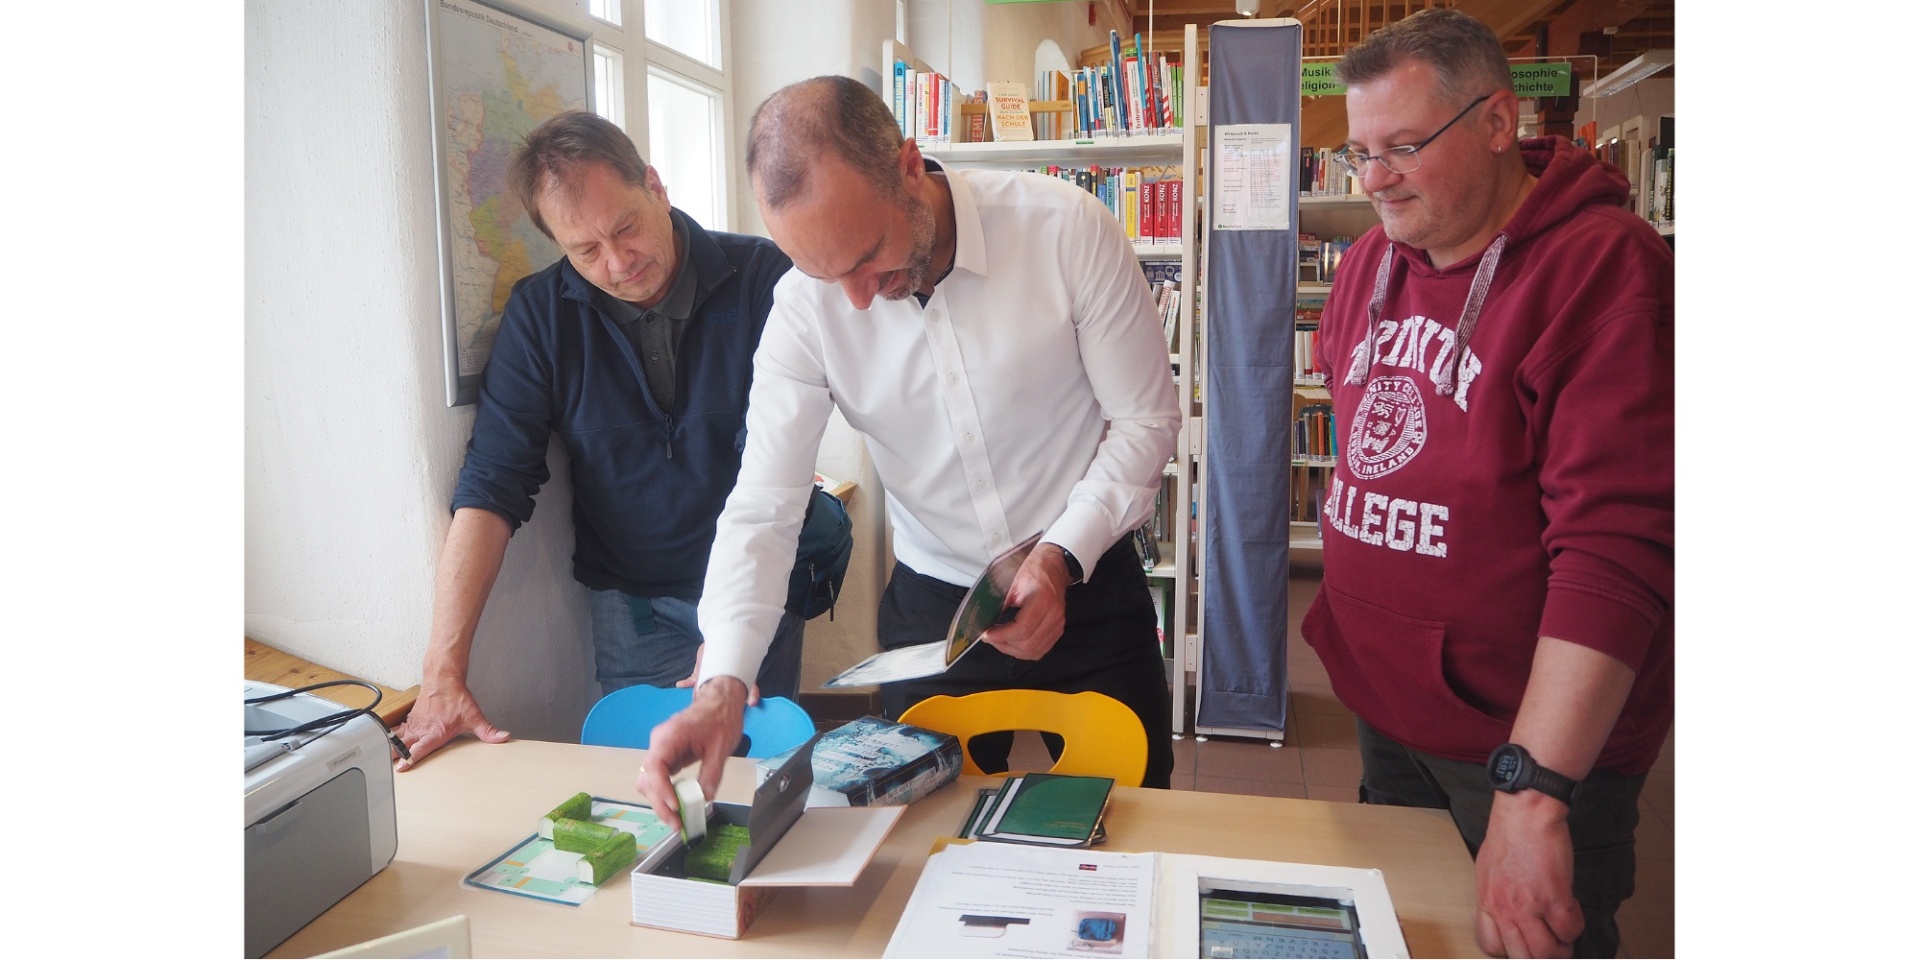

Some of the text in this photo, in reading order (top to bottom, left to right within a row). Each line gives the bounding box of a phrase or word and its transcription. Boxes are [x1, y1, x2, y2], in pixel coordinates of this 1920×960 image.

[440, 0, 518, 33] Bundesrepublik Deutschland
[1302, 67, 1331, 77] Musik
[1511, 68, 1558, 80] osophie
[1361, 446, 1414, 474] IRELAND
